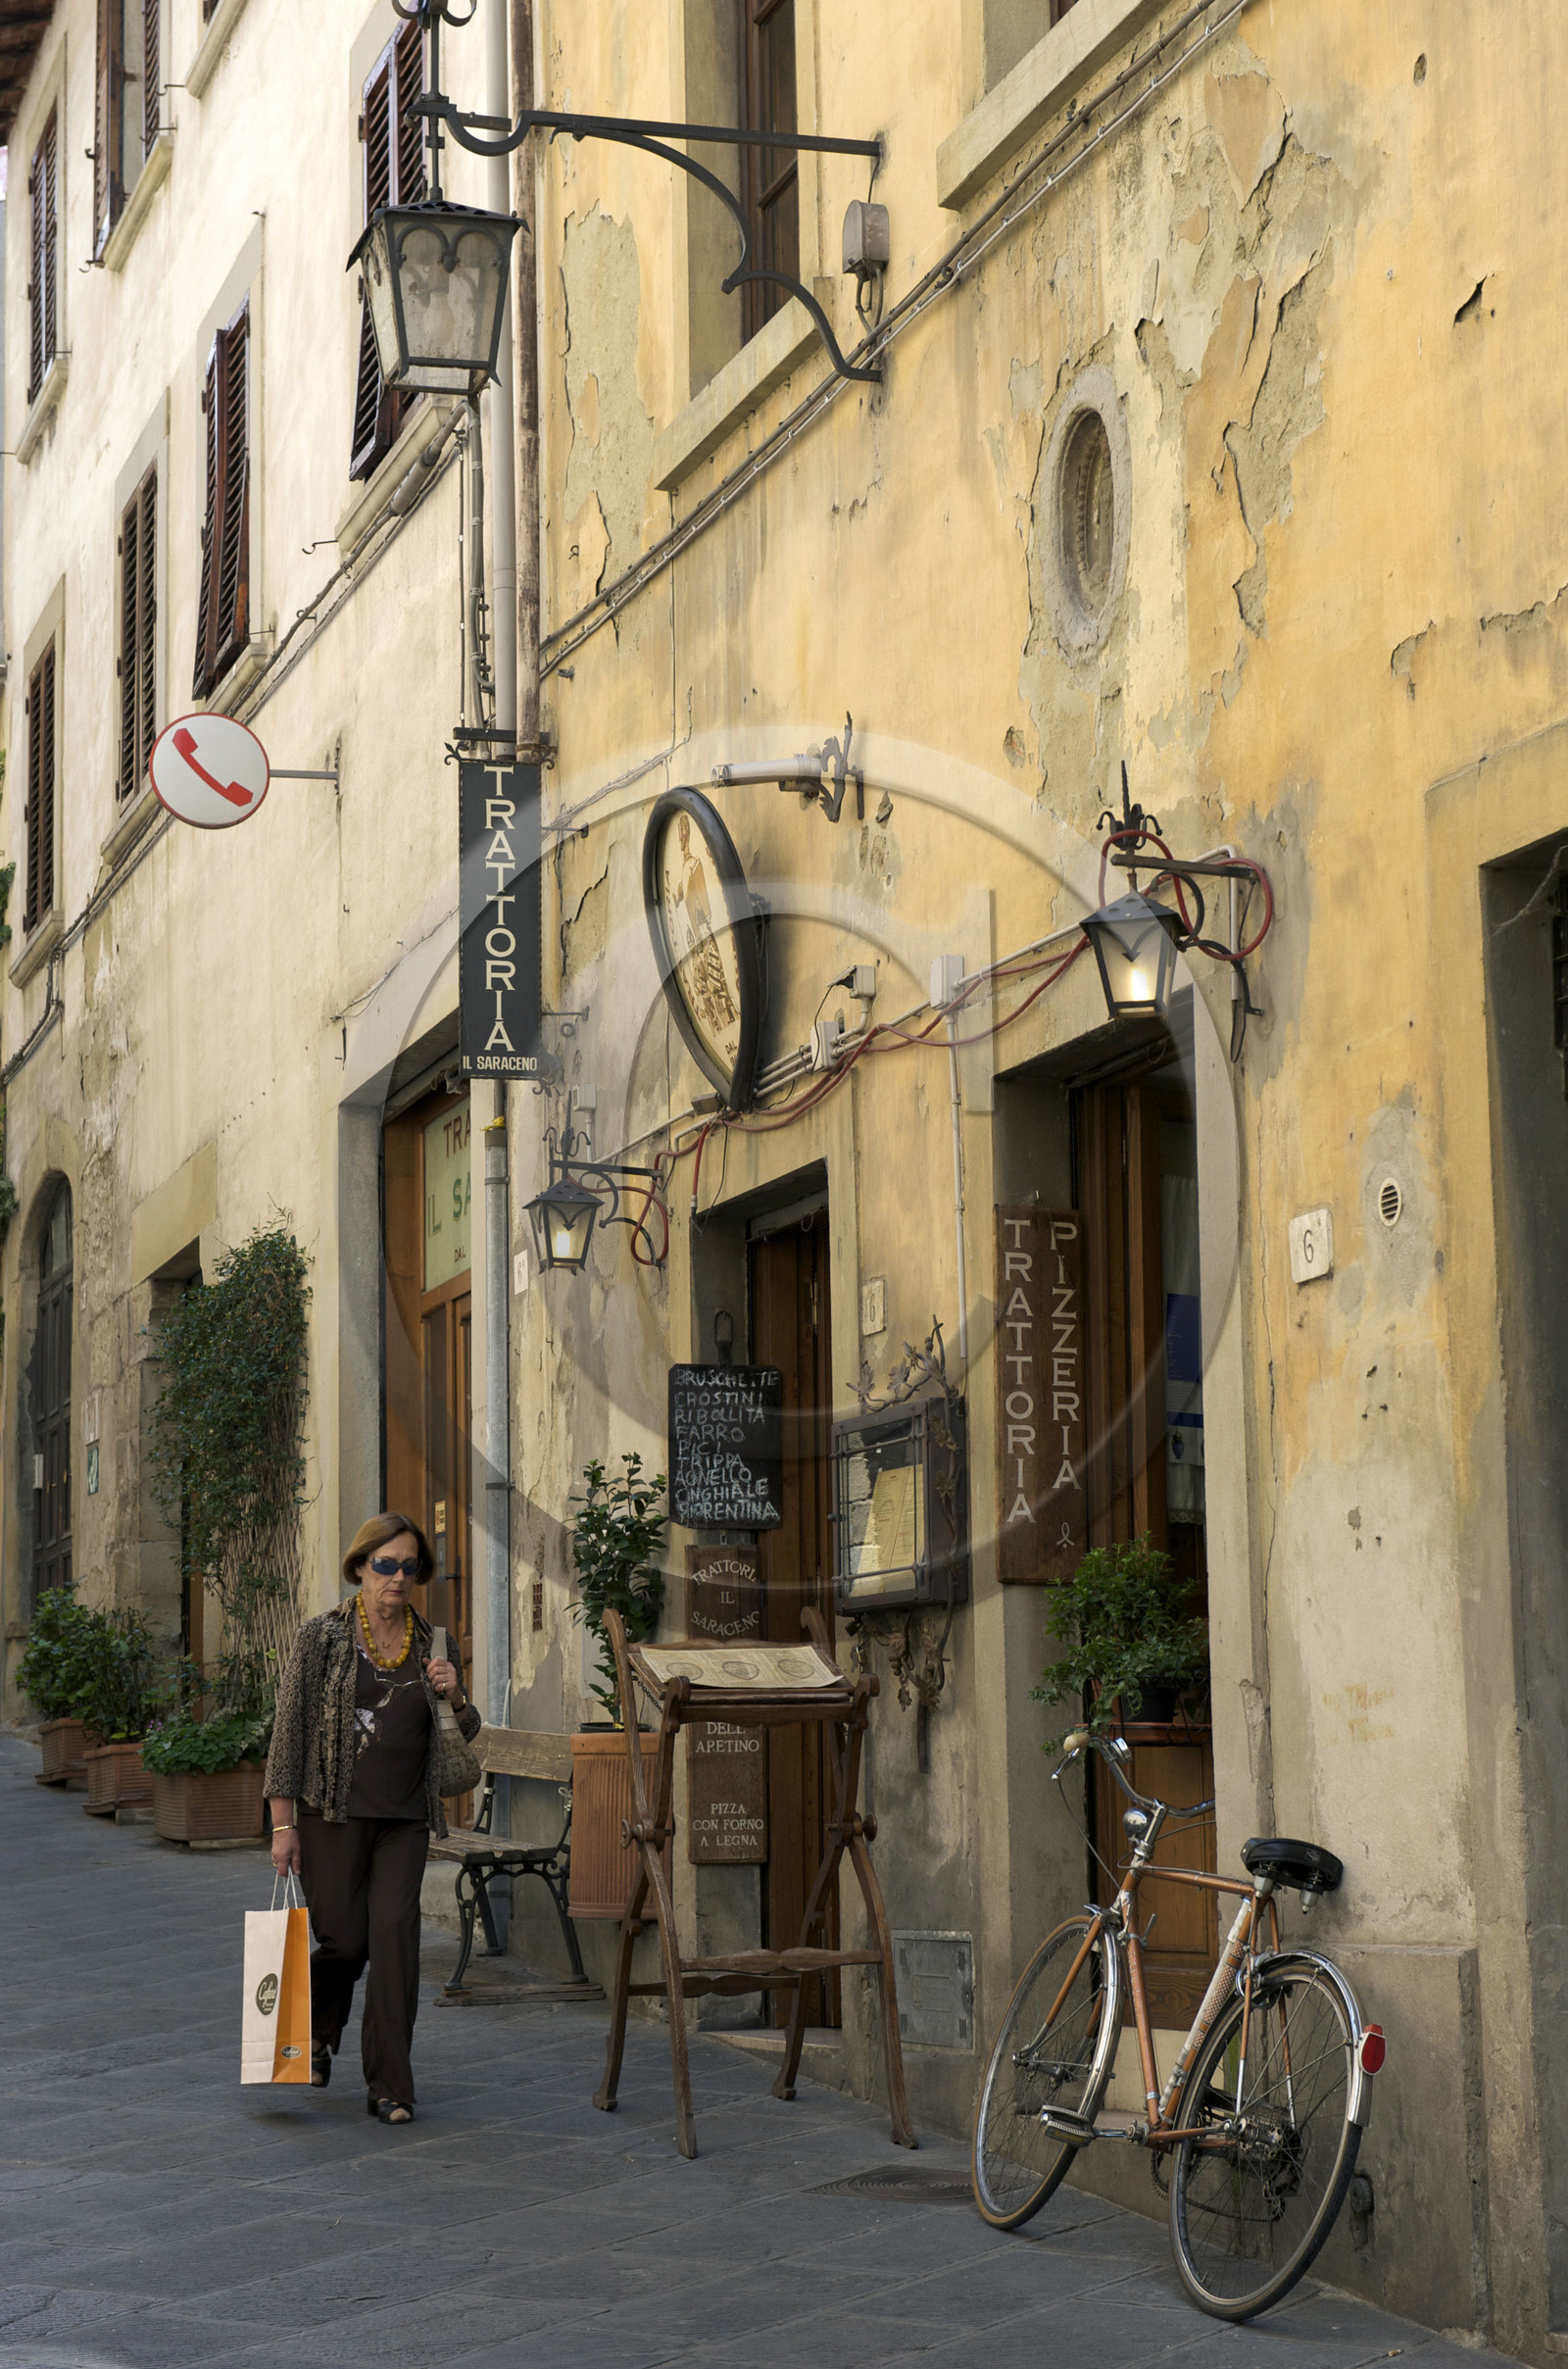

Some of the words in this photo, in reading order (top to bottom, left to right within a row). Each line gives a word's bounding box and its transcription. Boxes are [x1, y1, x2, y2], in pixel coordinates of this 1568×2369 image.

[483, 765, 516, 1052] TRATTORIA
[462, 1055, 472, 1070] IL
[476, 1055, 538, 1071] SARACENO
[427, 1193, 443, 1240] IL
[454, 1245, 466, 1263] DAL
[1303, 1229, 1314, 1263] 6
[1050, 1219, 1082, 1490] PIZZERIA
[1004, 1217, 1037, 1524] TRATTORIA
[674, 1391, 763, 1407] CROSTINI
[674, 1406, 765, 1425] RIBOLLITA
[675, 1421, 746, 1443] FARRO
[677, 1440, 721, 1457] PICI
[677, 1453, 744, 1469] TRIPPA
[674, 1477, 769, 1502] CINGHIALE
[675, 1497, 781, 1521] FIORENTINA
[690, 1559, 757, 1586] TRATTORI
[719, 1591, 736, 1604] IL
[695, 1739, 760, 1753] ARETINO
[710, 1802, 747, 1814] PIZZA
[692, 1819, 718, 1831] CON
[723, 1818, 764, 1831] FORNO
[700, 1836, 710, 1847] A
[716, 1835, 759, 1847] LEGNA
